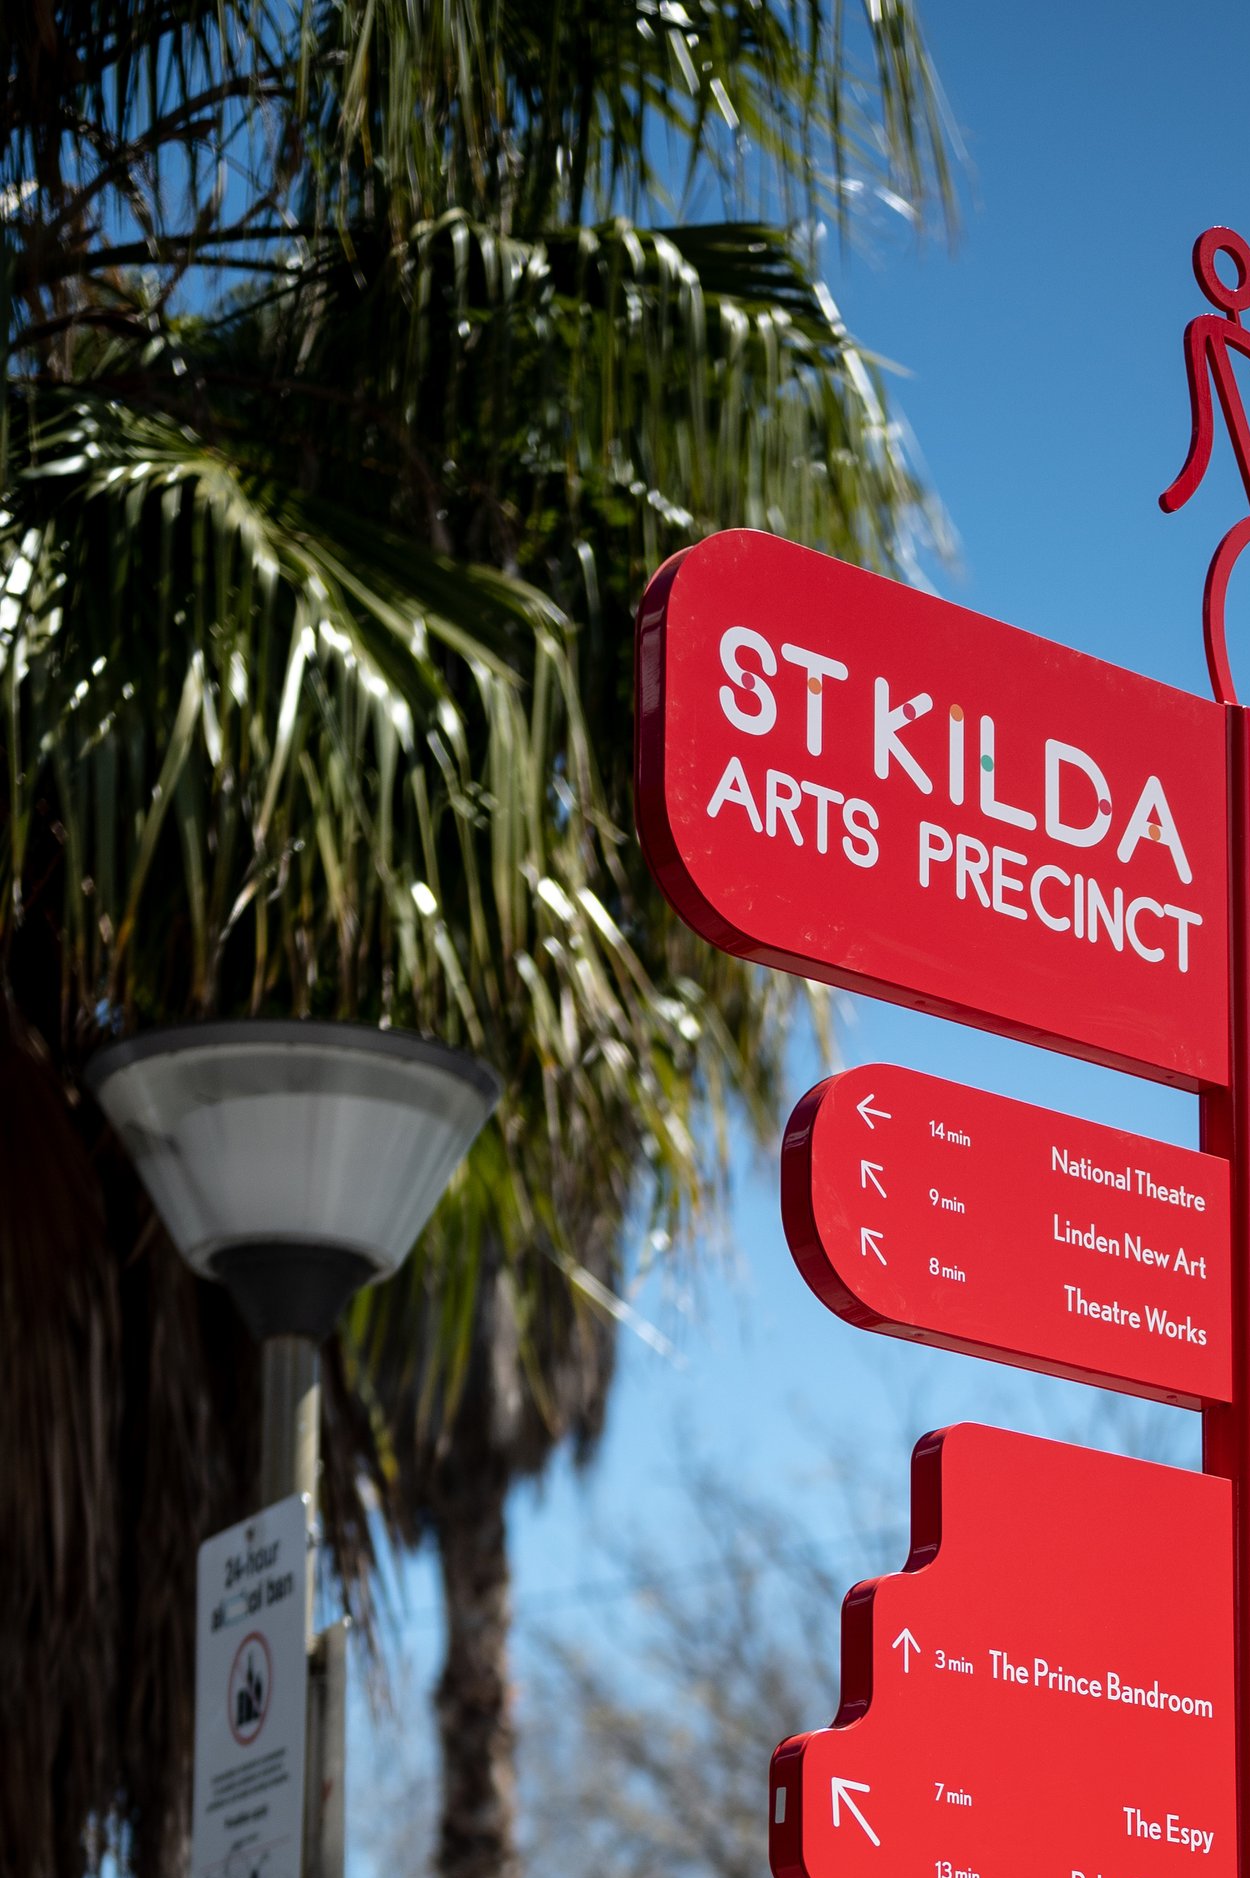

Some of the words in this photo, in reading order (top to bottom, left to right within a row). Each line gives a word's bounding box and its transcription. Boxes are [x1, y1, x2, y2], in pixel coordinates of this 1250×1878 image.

[719, 626, 848, 756] ST
[874, 676, 1192, 884] KILDA
[707, 756, 879, 868] ARTS
[920, 820, 1202, 972] PRECINCT
[929, 1120, 945, 1139] 14
[948, 1130, 970, 1146] min
[930, 1189, 939, 1205] 9
[942, 1197, 964, 1213] min
[1052, 1146, 1130, 1191] National
[1135, 1170, 1205, 1211] Theatre
[929, 1258, 939, 1275] 8
[942, 1266, 965, 1282] min
[1054, 1214, 1119, 1256] Linden
[1125, 1233, 1169, 1268] New
[1174, 1248, 1206, 1279] Art
[1064, 1285, 1140, 1328] Theatre
[1145, 1306, 1206, 1345] Works
[935, 1650, 945, 1668] 3
[949, 1657, 973, 1674] min
[989, 1650, 1028, 1684] The
[1035, 1658, 1102, 1697] Prince
[1108, 1672, 1212, 1718] Bandroom
[935, 1783, 944, 1800] 7
[947, 1789, 971, 1806] min
[1123, 1807, 1161, 1839] The
[1167, 1814, 1214, 1853] Espy
